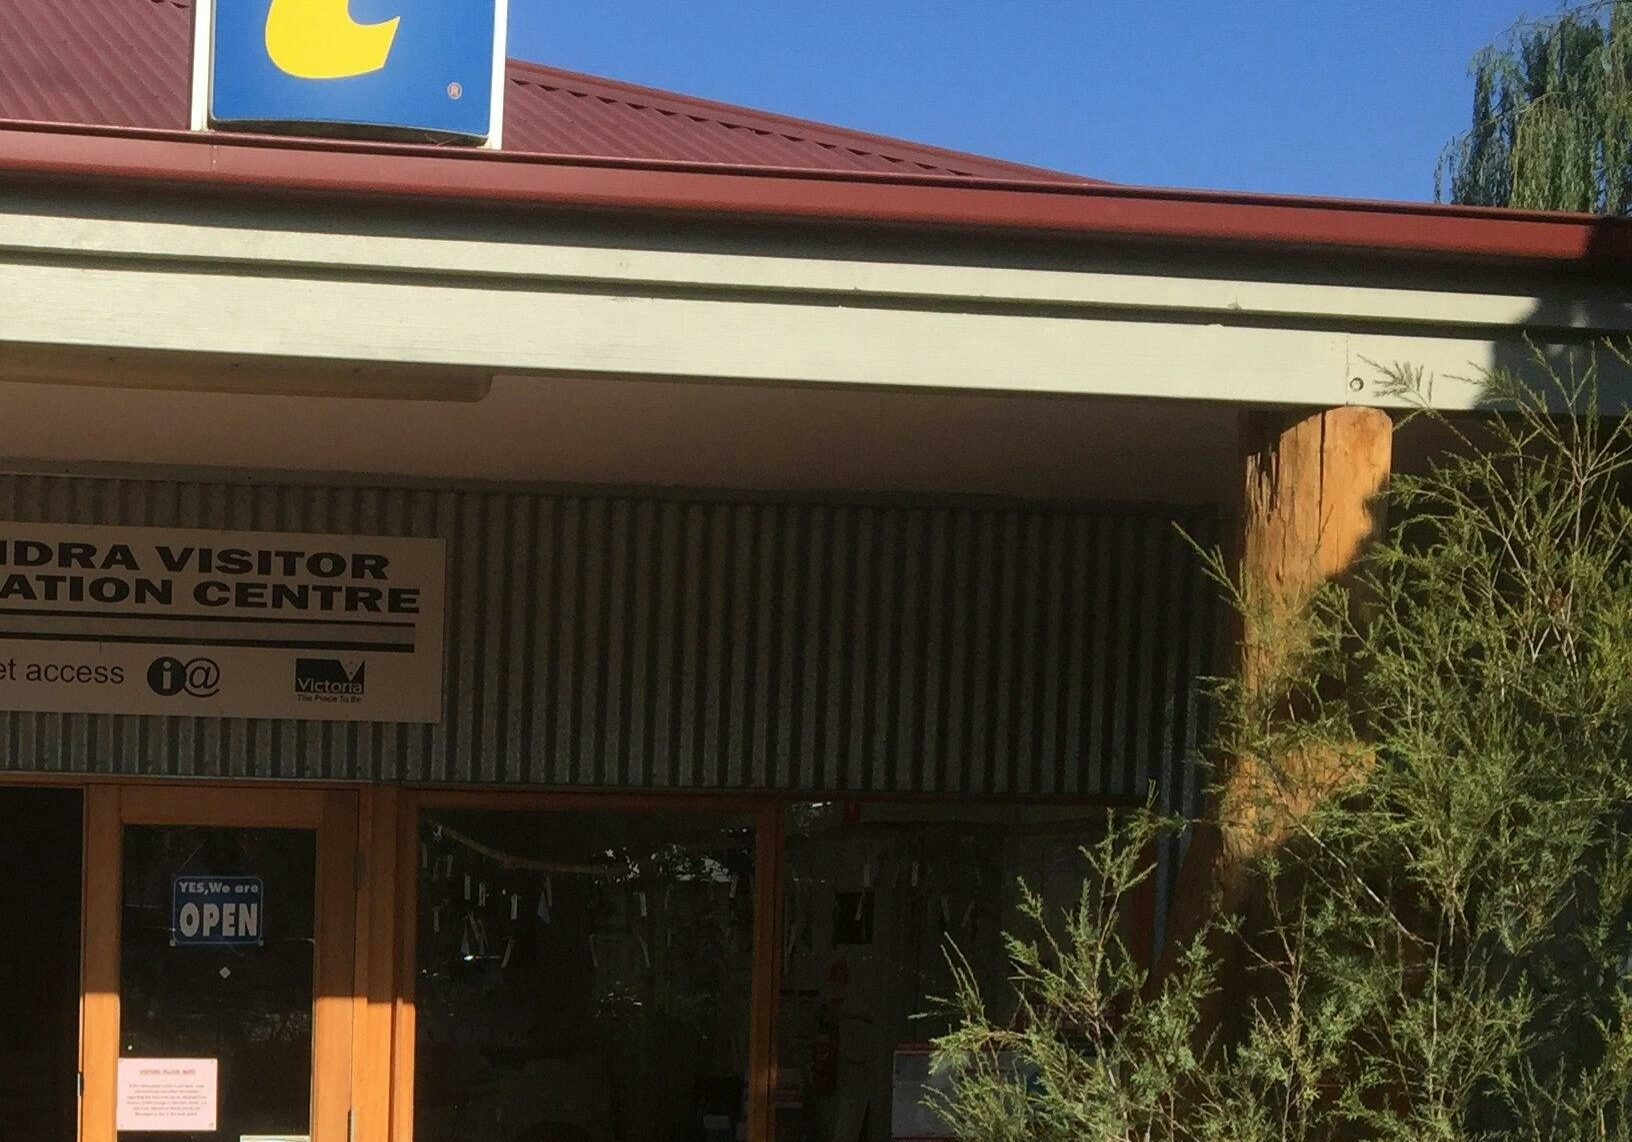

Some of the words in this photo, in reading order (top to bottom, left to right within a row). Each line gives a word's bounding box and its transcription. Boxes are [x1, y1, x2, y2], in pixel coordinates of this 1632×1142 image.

[156, 546, 389, 579] VISITOR
[193, 581, 421, 614] CENTRE
[26, 664, 124, 684] access
[297, 677, 363, 693] Victoria
[234, 884, 259, 894] are
[179, 902, 258, 937] OPEN
